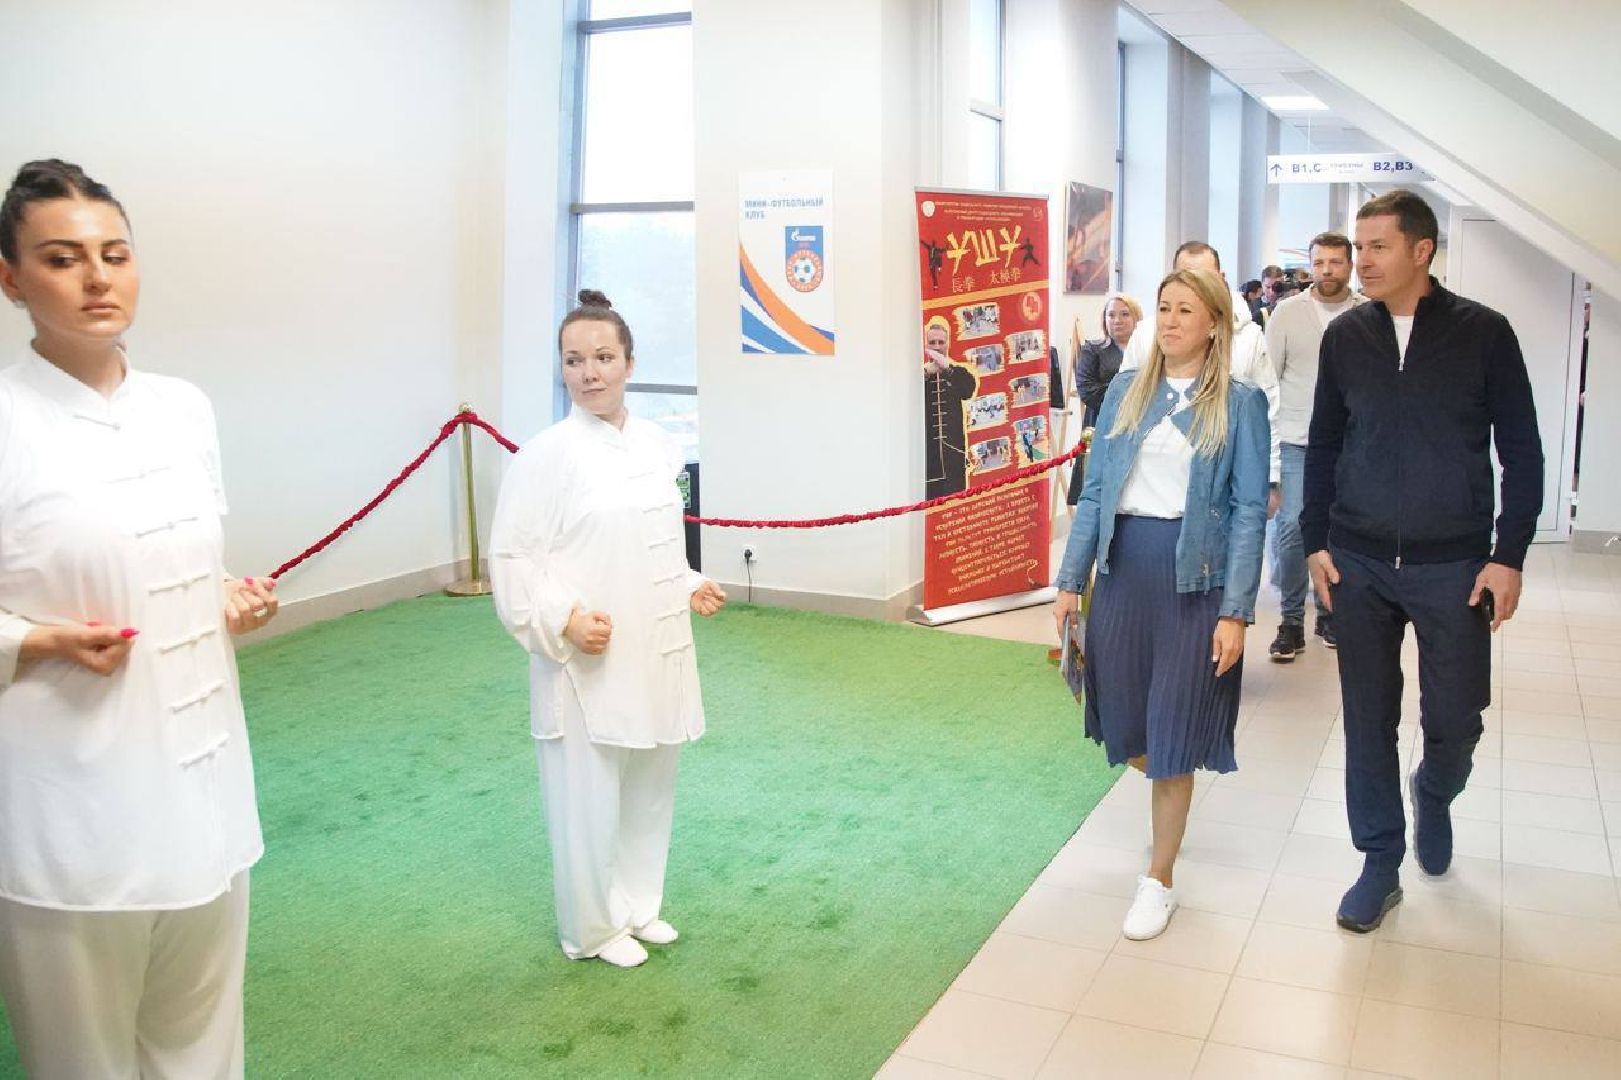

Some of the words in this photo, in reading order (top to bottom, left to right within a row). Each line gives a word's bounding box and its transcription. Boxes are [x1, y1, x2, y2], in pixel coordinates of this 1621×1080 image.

[745, 197, 824, 208] МИНИ-ФУТБОЛЬНЫЙ
[745, 211, 765, 220] КЛУБ
[946, 225, 1022, 277] УШУ
